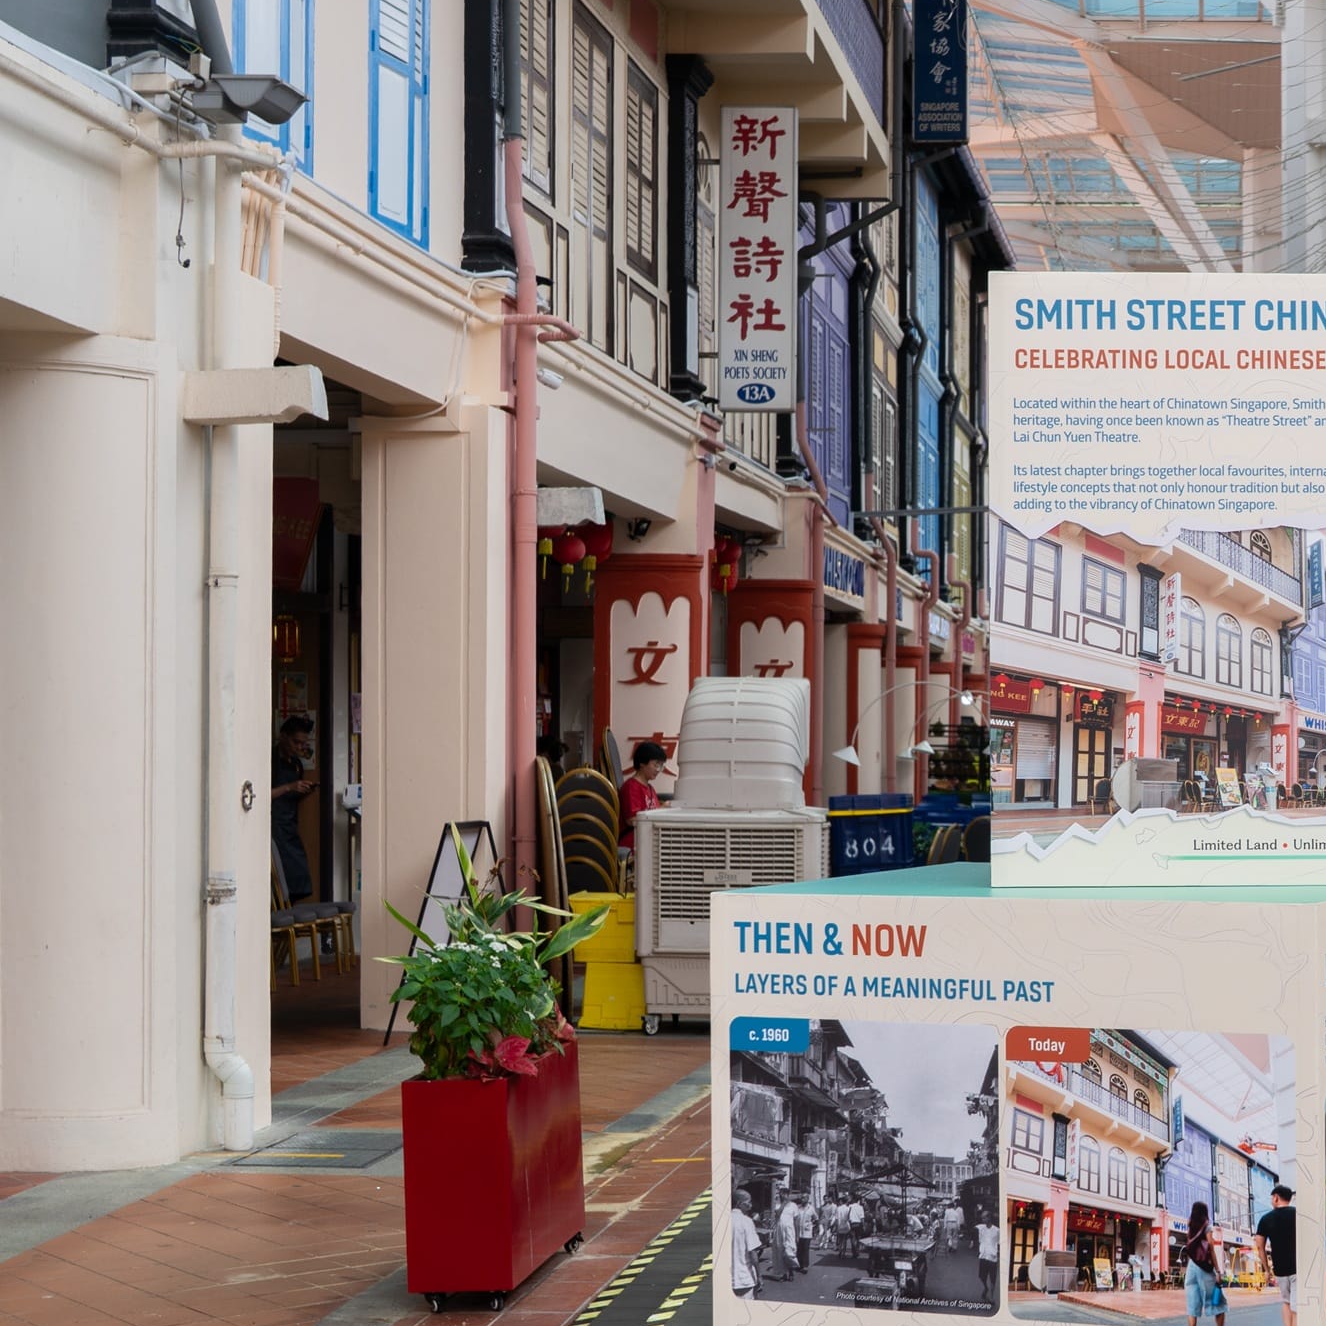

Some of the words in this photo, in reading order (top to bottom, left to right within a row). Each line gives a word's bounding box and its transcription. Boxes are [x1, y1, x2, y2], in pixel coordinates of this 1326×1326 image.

[920, 102, 959, 111] SINGAPORE
[918, 112, 962, 121] ASSOCIATION
[919, 122, 929, 131] OF
[931, 122, 961, 132] WRITERS
[727, 115, 788, 341] 新聲詩社
[1016, 299, 1115, 331] SMITH
[1127, 299, 1245, 331] STREET
[734, 349, 747, 363] XIN
[749, 349, 779, 364] SHENG
[1015, 349, 1157, 369] CELEBRATING
[1166, 349, 1230, 370] LOCAL
[1237, 350, 1326, 370] CHINESE
[724, 365, 752, 380] POETS
[754, 366, 787, 381] SOCIETY
[743, 385, 772, 402] 13A
[1014, 397, 1057, 410] Located
[1061, 397, 1096, 410] within
[1099, 397, 1117, 410] the
[1120, 397, 1150, 410] heart
[1153, 397, 1165, 410] of
[1167, 397, 1228, 410] Chinatown
[1231, 397, 1290, 414] Singapore,
[1293, 397, 1326, 410] Smith
[1194, 839, 1241, 850] Limited
[1247, 839, 1277, 850] Land
[734, 921, 812, 954] THEN
[823, 922, 843, 956] &
[853, 923, 927, 957] NOW
[736, 973, 807, 995] LAYERS
[814, 975, 837, 996] OF
[844, 976, 856, 997] A
[863, 976, 996, 1001] MEANINGFUL
[1004, 980, 1054, 1003] PAST
[749, 1031, 759, 1040] c.
[762, 1028, 789, 1041] 1960
[1028, 1038, 1065, 1055] Today
[836, 1292, 855, 1301] Photo
[857, 1294, 883, 1303] courtesy
[893, 1294, 920, 1307] National
[921, 1298, 948, 1307] Archives
[958, 1300, 991, 1310] Singapore
